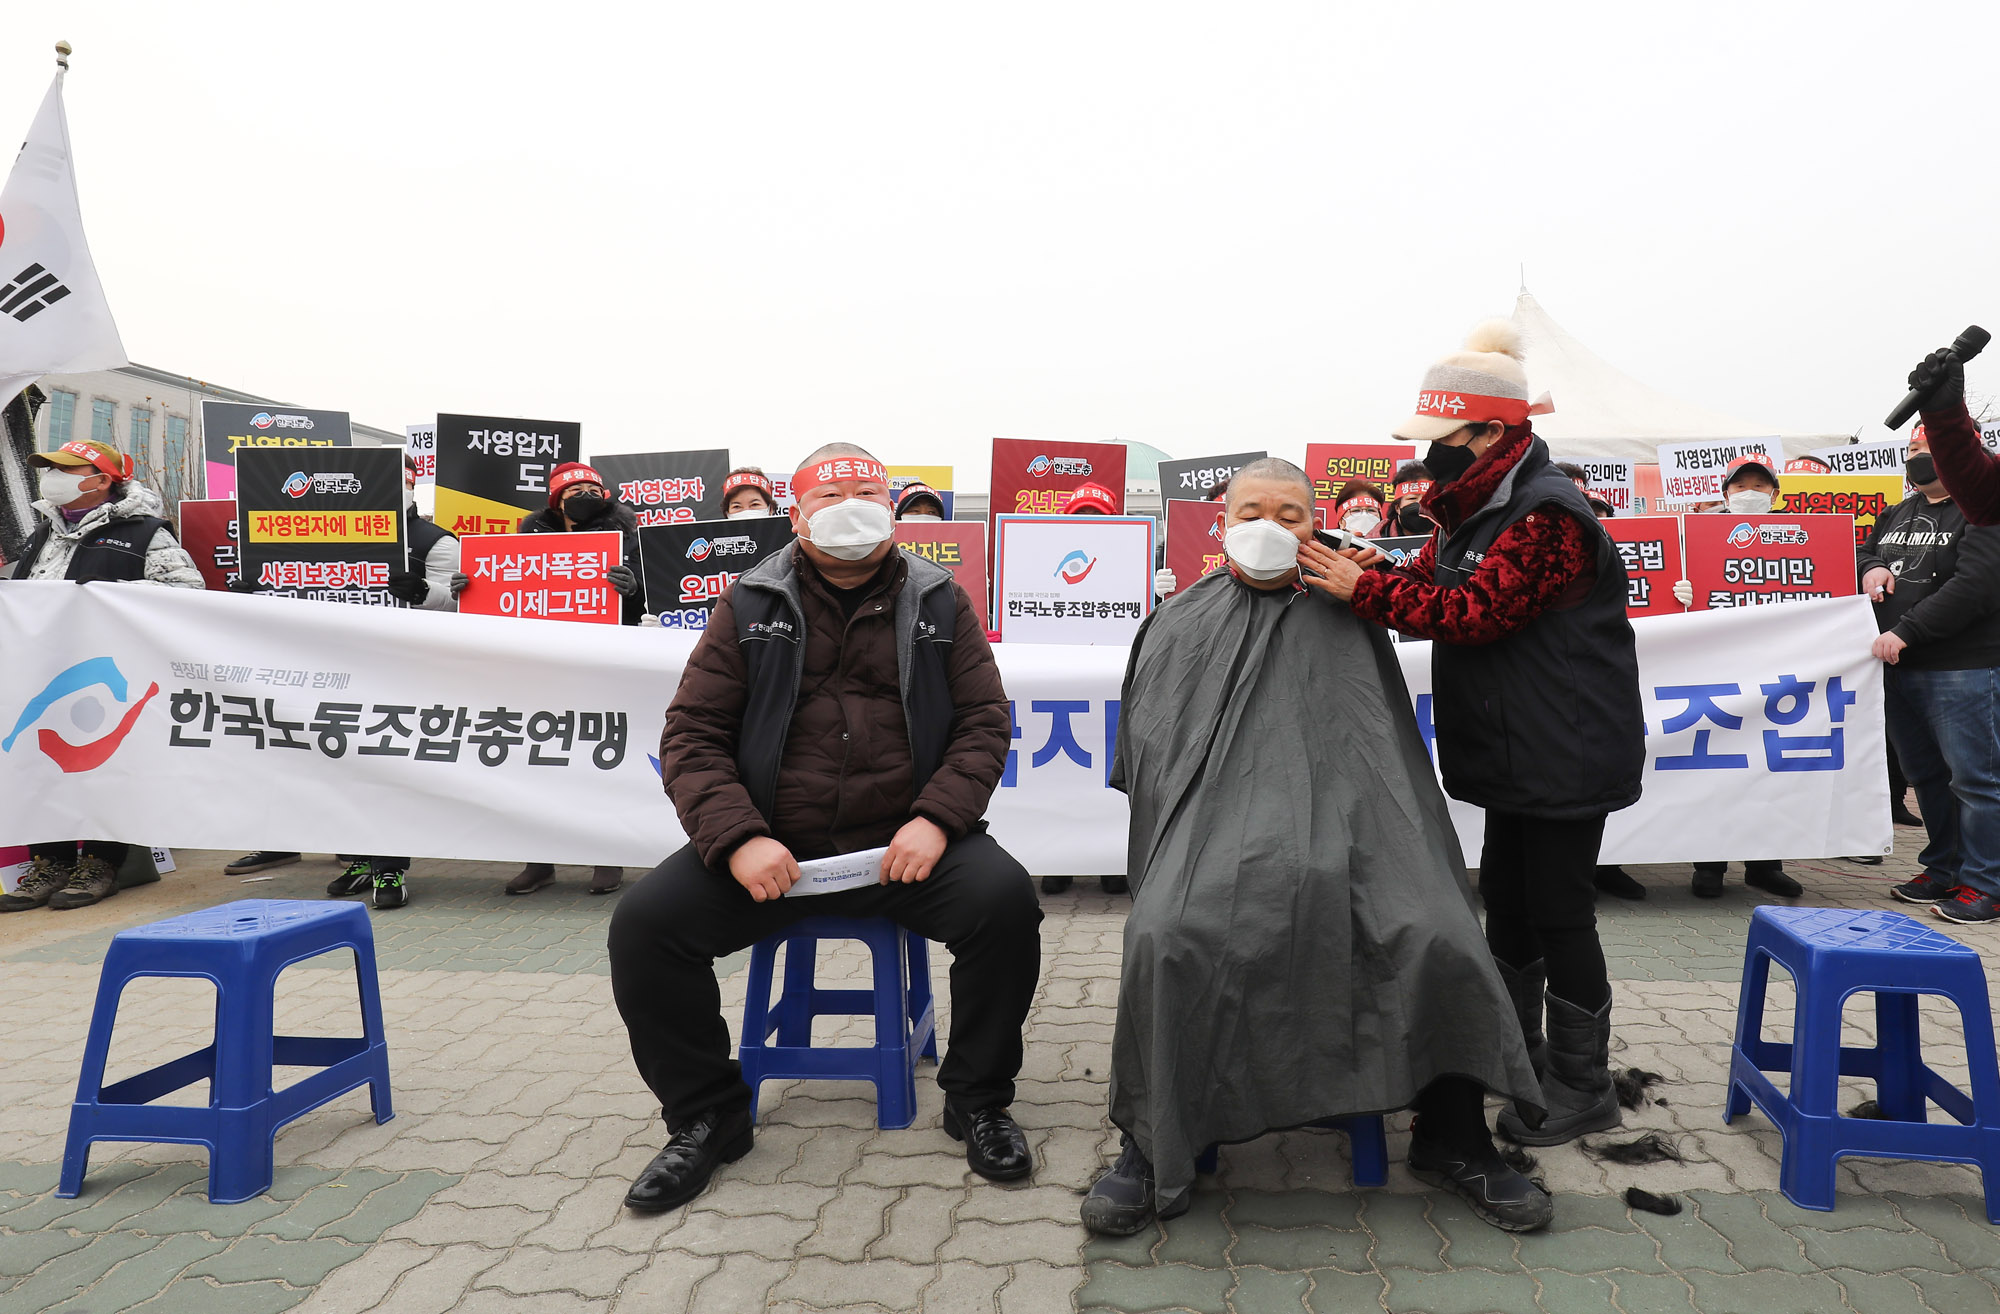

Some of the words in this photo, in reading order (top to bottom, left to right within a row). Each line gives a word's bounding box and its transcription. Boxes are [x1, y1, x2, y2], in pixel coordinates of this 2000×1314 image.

[1417, 394, 1466, 414] 권사수
[411, 431, 436, 449] 자영
[466, 430, 562, 459] 자영업자
[1054, 463, 1092, 475] 한국노총
[1327, 457, 1391, 478] 5인미만
[1828, 447, 1897, 473] 자영업자에
[1180, 466, 1241, 490] 자영업
[1584, 464, 1627, 482] 5인미만
[314, 478, 361, 494] 한국노총
[620, 477, 704, 503] 자영업자
[1665, 475, 1720, 498] 사회보장제도
[1783, 492, 1886, 517] 자영업자
[256, 515, 347, 537] 자영업자에
[354, 515, 391, 536] 대한
[1760, 530, 1807, 544] 한국노총
[715, 541, 757, 556] 한국노총
[259, 563, 390, 588] 사회보장제도
[473, 551, 608, 582] 자살자폭증!
[1725, 558, 1813, 584] 5인미만
[680, 573, 738, 600] 오미
[499, 587, 608, 618] 이제그만!
[1008, 600, 1141, 619] 한국노동조합총연맹
[170, 661, 209, 681] 현장과
[213, 664, 253, 684] 함께!
[256, 668, 308, 688] 국민과
[312, 672, 351, 690] 함께!
[169, 688, 628, 770] 한국노동조합총연맹
